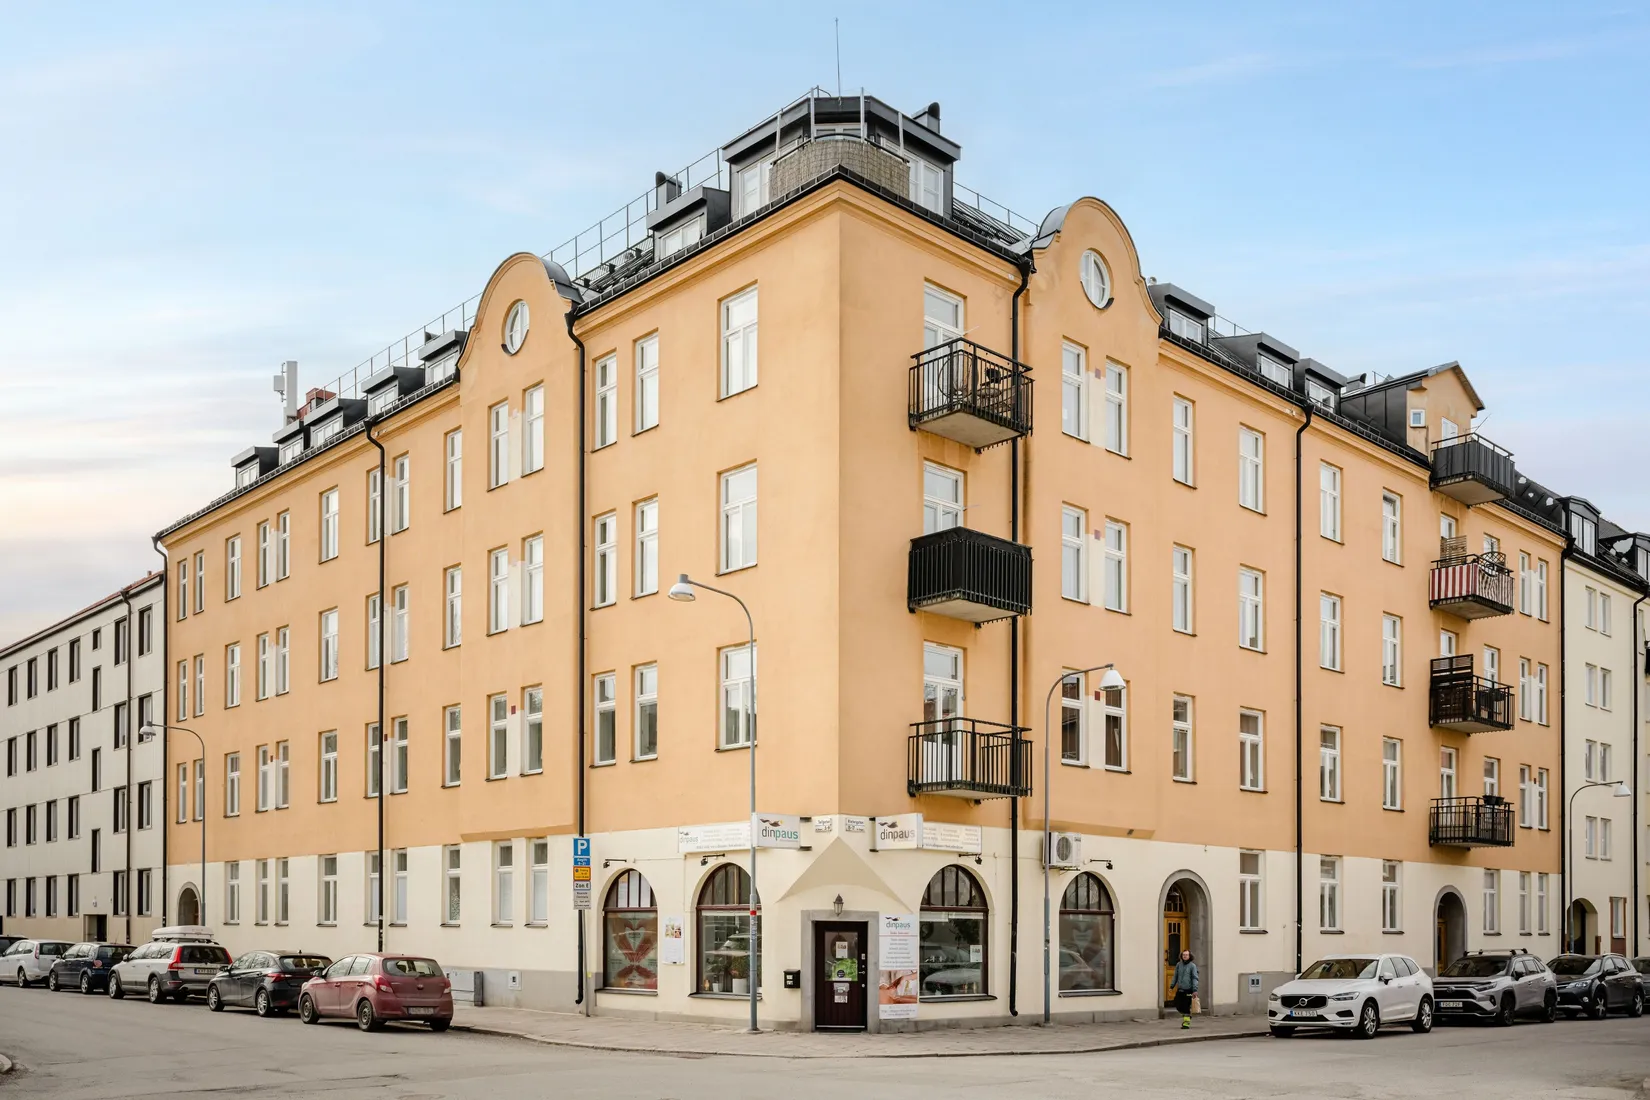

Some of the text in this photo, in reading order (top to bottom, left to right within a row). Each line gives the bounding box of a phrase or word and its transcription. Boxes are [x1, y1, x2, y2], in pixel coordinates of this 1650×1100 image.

[761, 826, 799, 841] dinpaus
[880, 829, 916, 842] dinpaus
[577, 839, 588, 855] P
[886, 922, 911, 930] dinpaus
